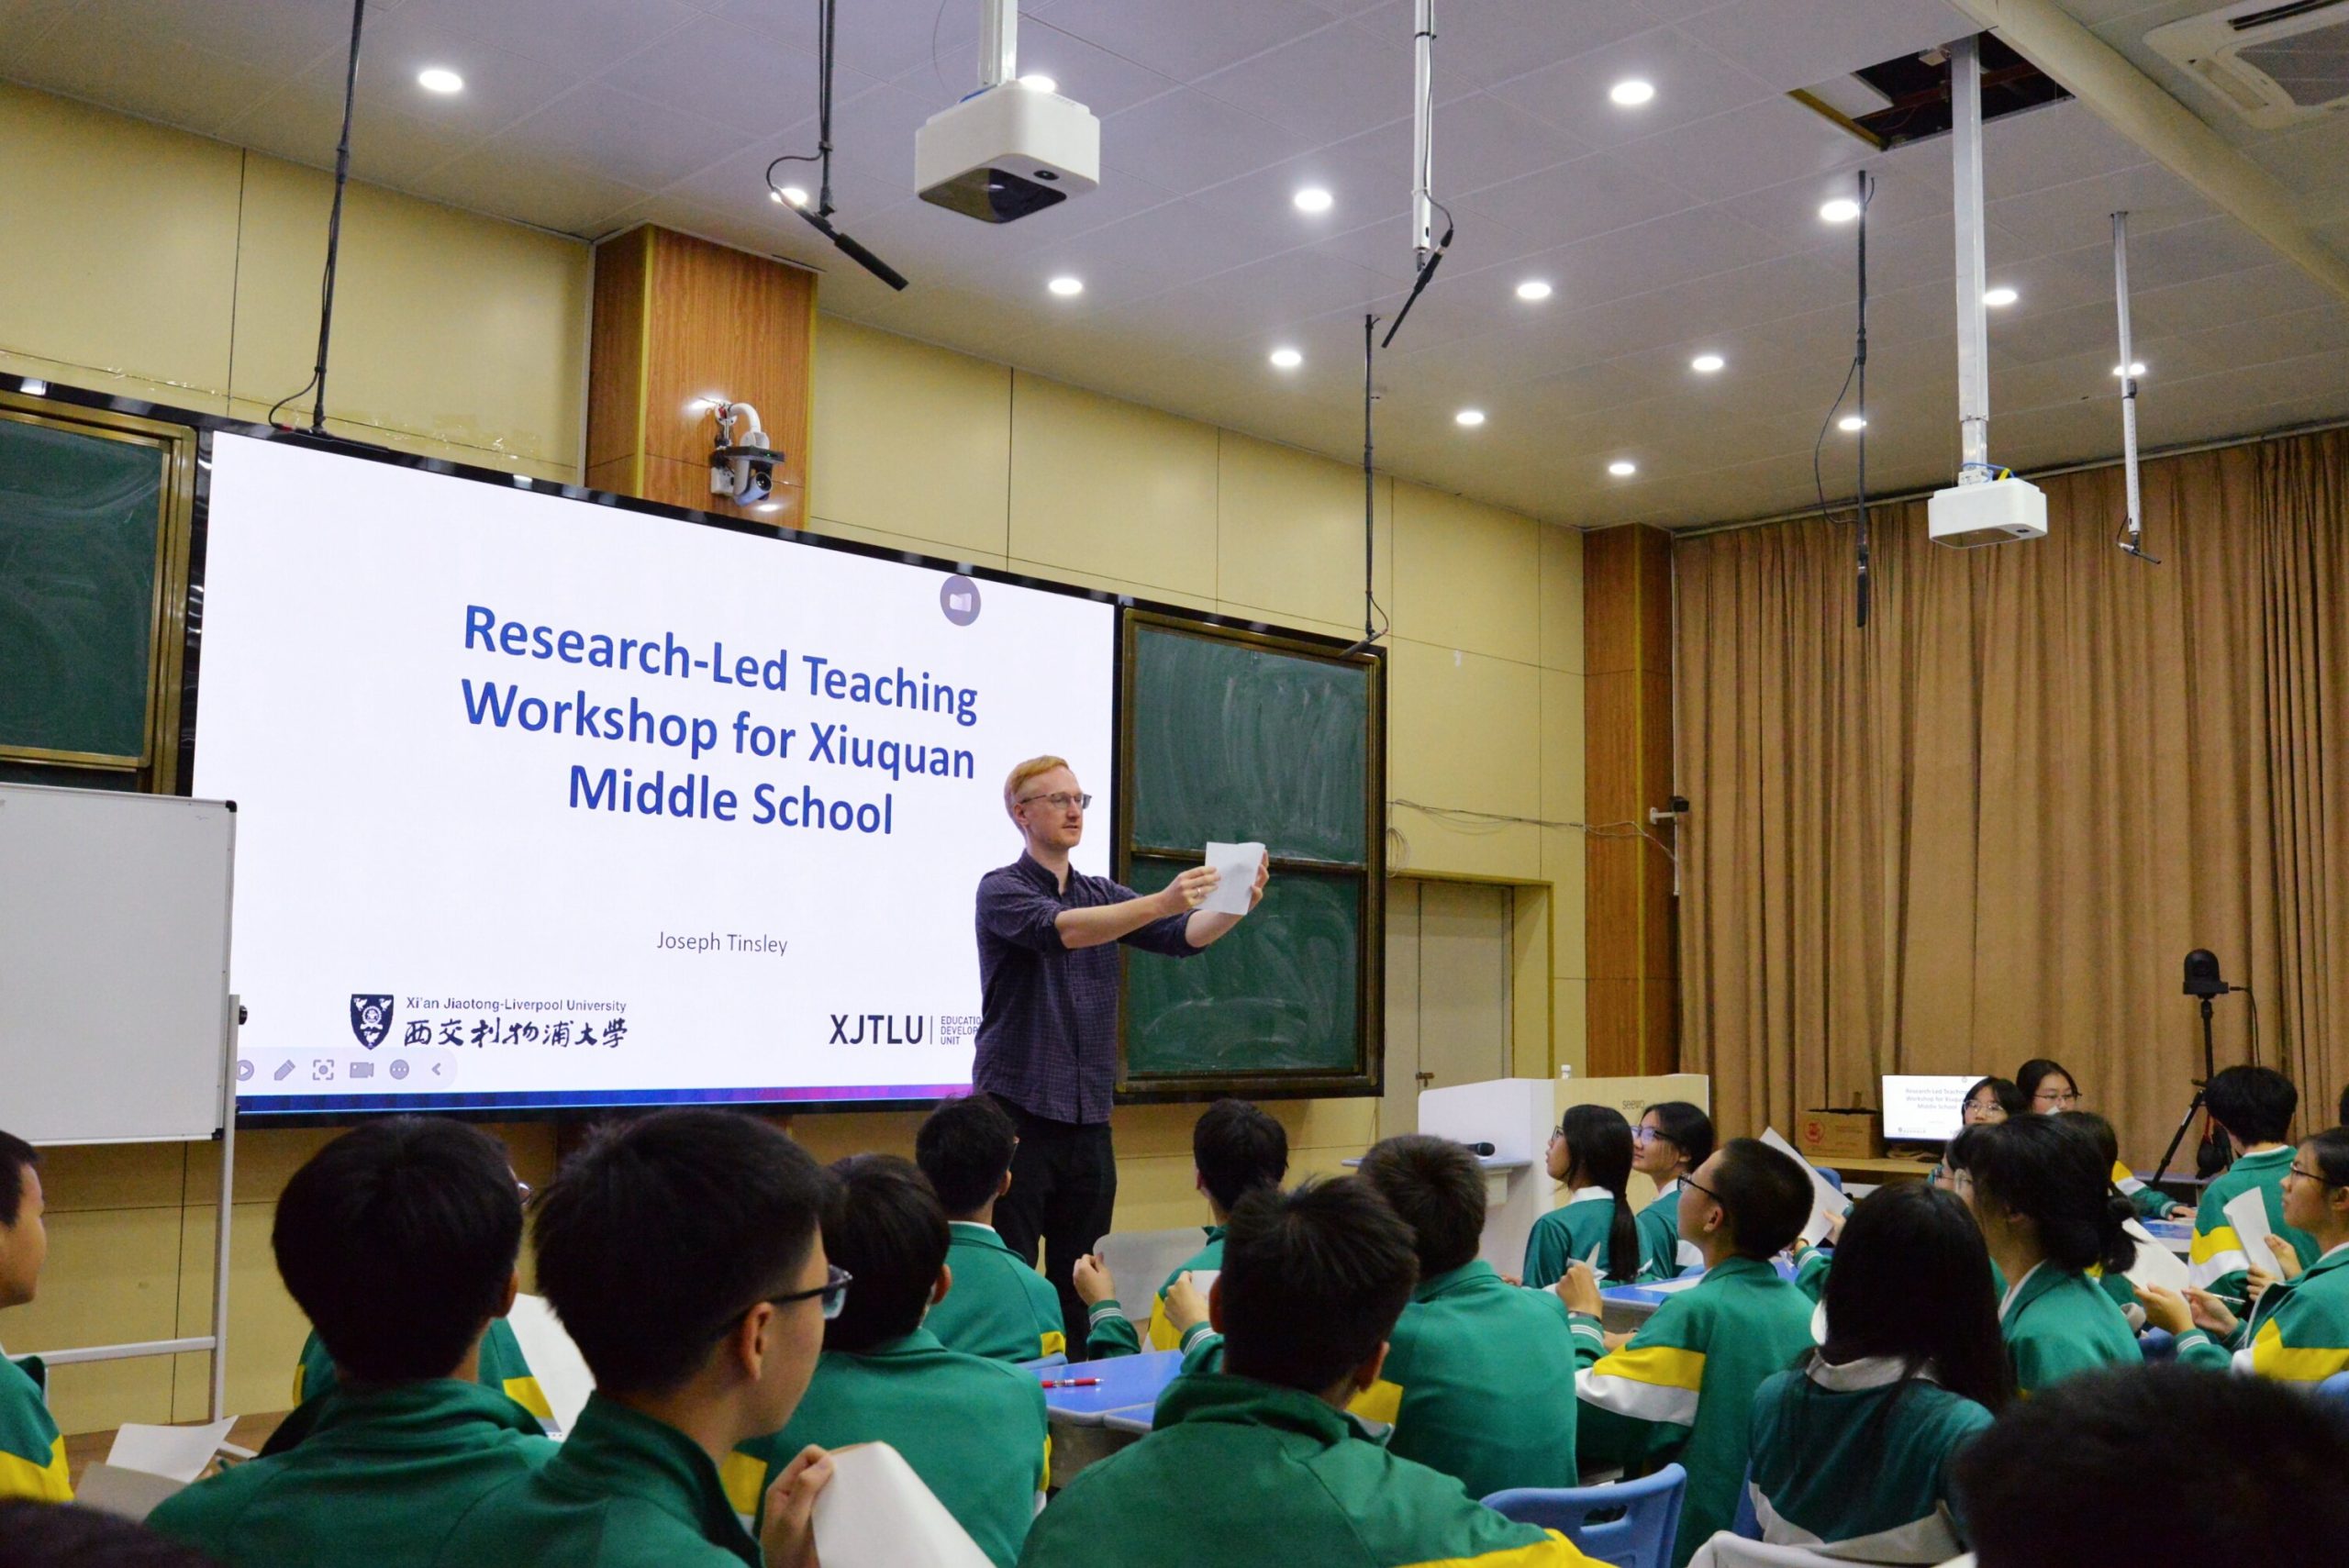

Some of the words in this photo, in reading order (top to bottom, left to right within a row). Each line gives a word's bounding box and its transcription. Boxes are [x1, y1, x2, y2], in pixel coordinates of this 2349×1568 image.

[465, 606, 787, 692] Research-Led
[803, 655, 978, 727] Teaching
[461, 678, 718, 761] Workshop
[732, 710, 796, 759] for
[808, 723, 974, 782] Xiuquan
[569, 764, 738, 822] Middle
[752, 783, 892, 835] School
[656, 931, 720, 954] Joseph
[726, 933, 788, 957] Tinsley
[406, 996, 440, 1009] Xi'an
[443, 997, 562, 1013] Jiaotong-Liverpool
[566, 999, 628, 1014] University
[829, 1014, 924, 1045] XJTLU
[941, 1016, 982, 1025] EDUCATIO
[941, 1026, 979, 1035] DEVELOP
[941, 1036, 961, 1045] UNIT
[1622, 1100, 1645, 1110] seewo
